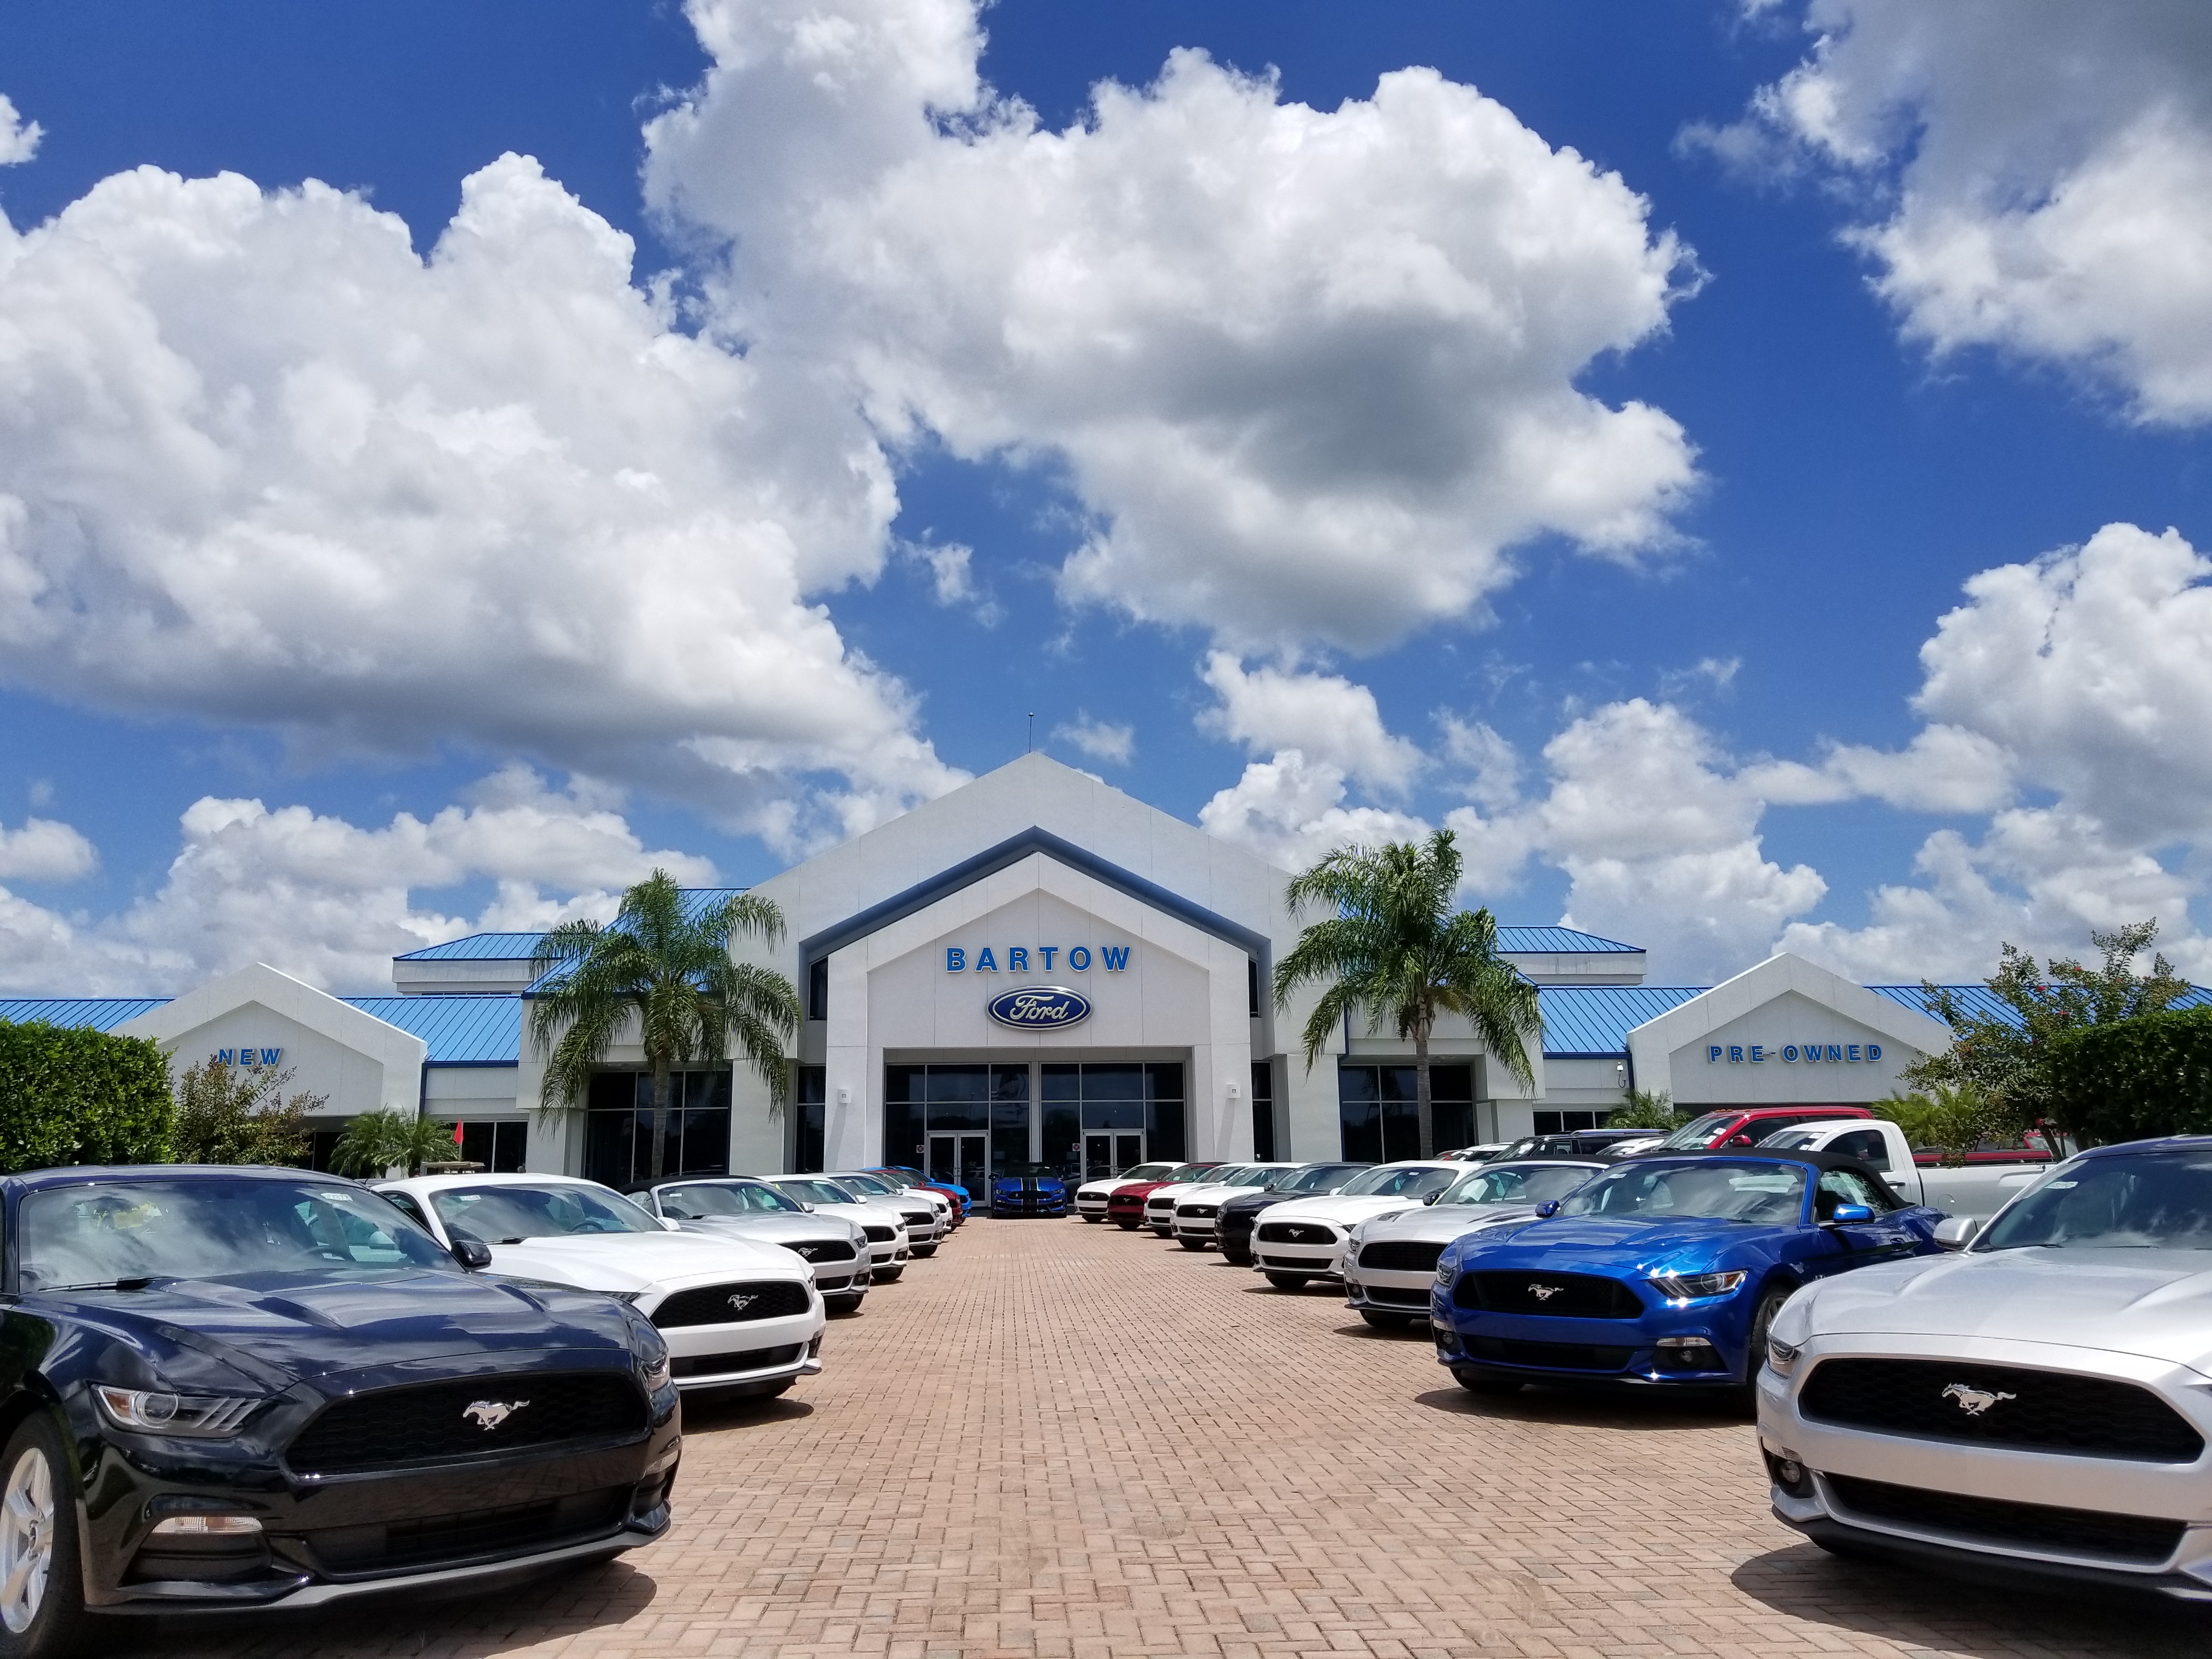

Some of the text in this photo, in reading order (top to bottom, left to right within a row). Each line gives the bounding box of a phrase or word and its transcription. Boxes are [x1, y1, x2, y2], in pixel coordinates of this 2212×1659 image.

[946, 945, 1131, 973] BARTOW
[1009, 995, 1070, 1020] Ford
[218, 1048, 281, 1066] NEW
[1708, 1044, 1882, 1063] PRE-OWNED
